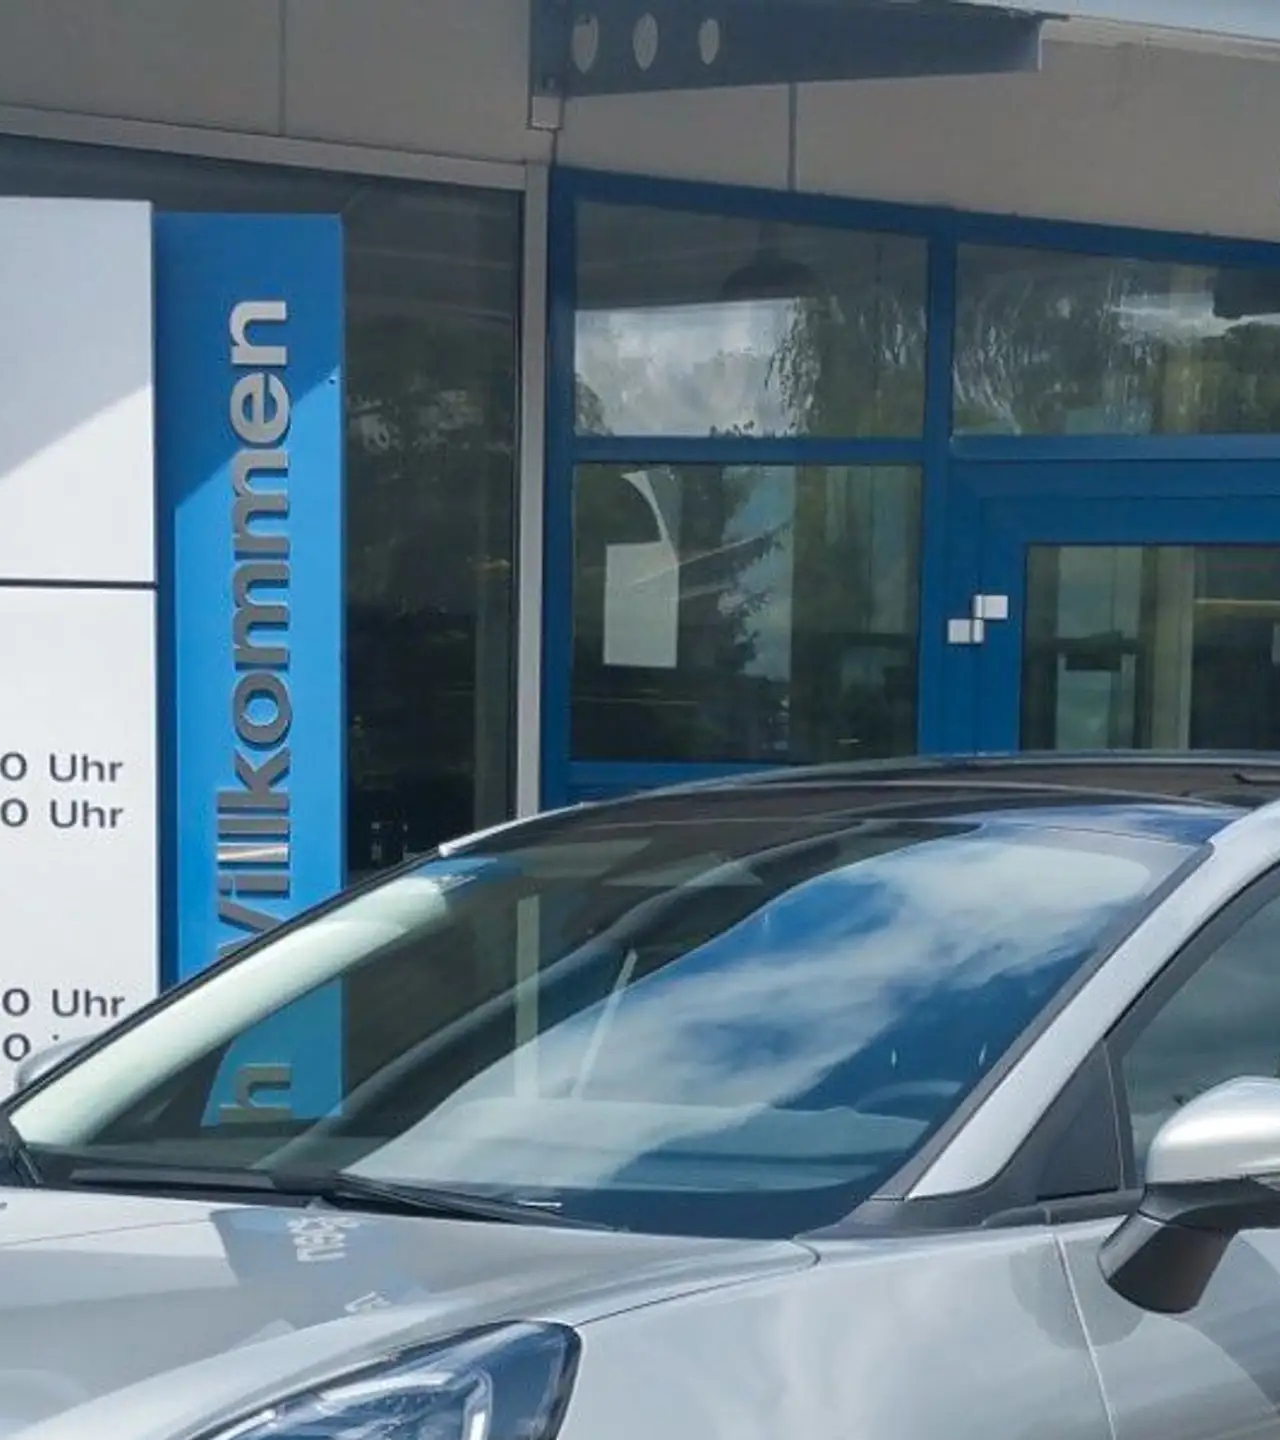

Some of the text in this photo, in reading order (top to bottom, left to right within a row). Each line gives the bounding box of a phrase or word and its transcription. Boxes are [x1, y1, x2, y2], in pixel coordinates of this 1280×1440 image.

[49, 752, 124, 783] Uhr
[49, 799, 124, 829] Uhr
[51, 988, 126, 1018] Uhr
